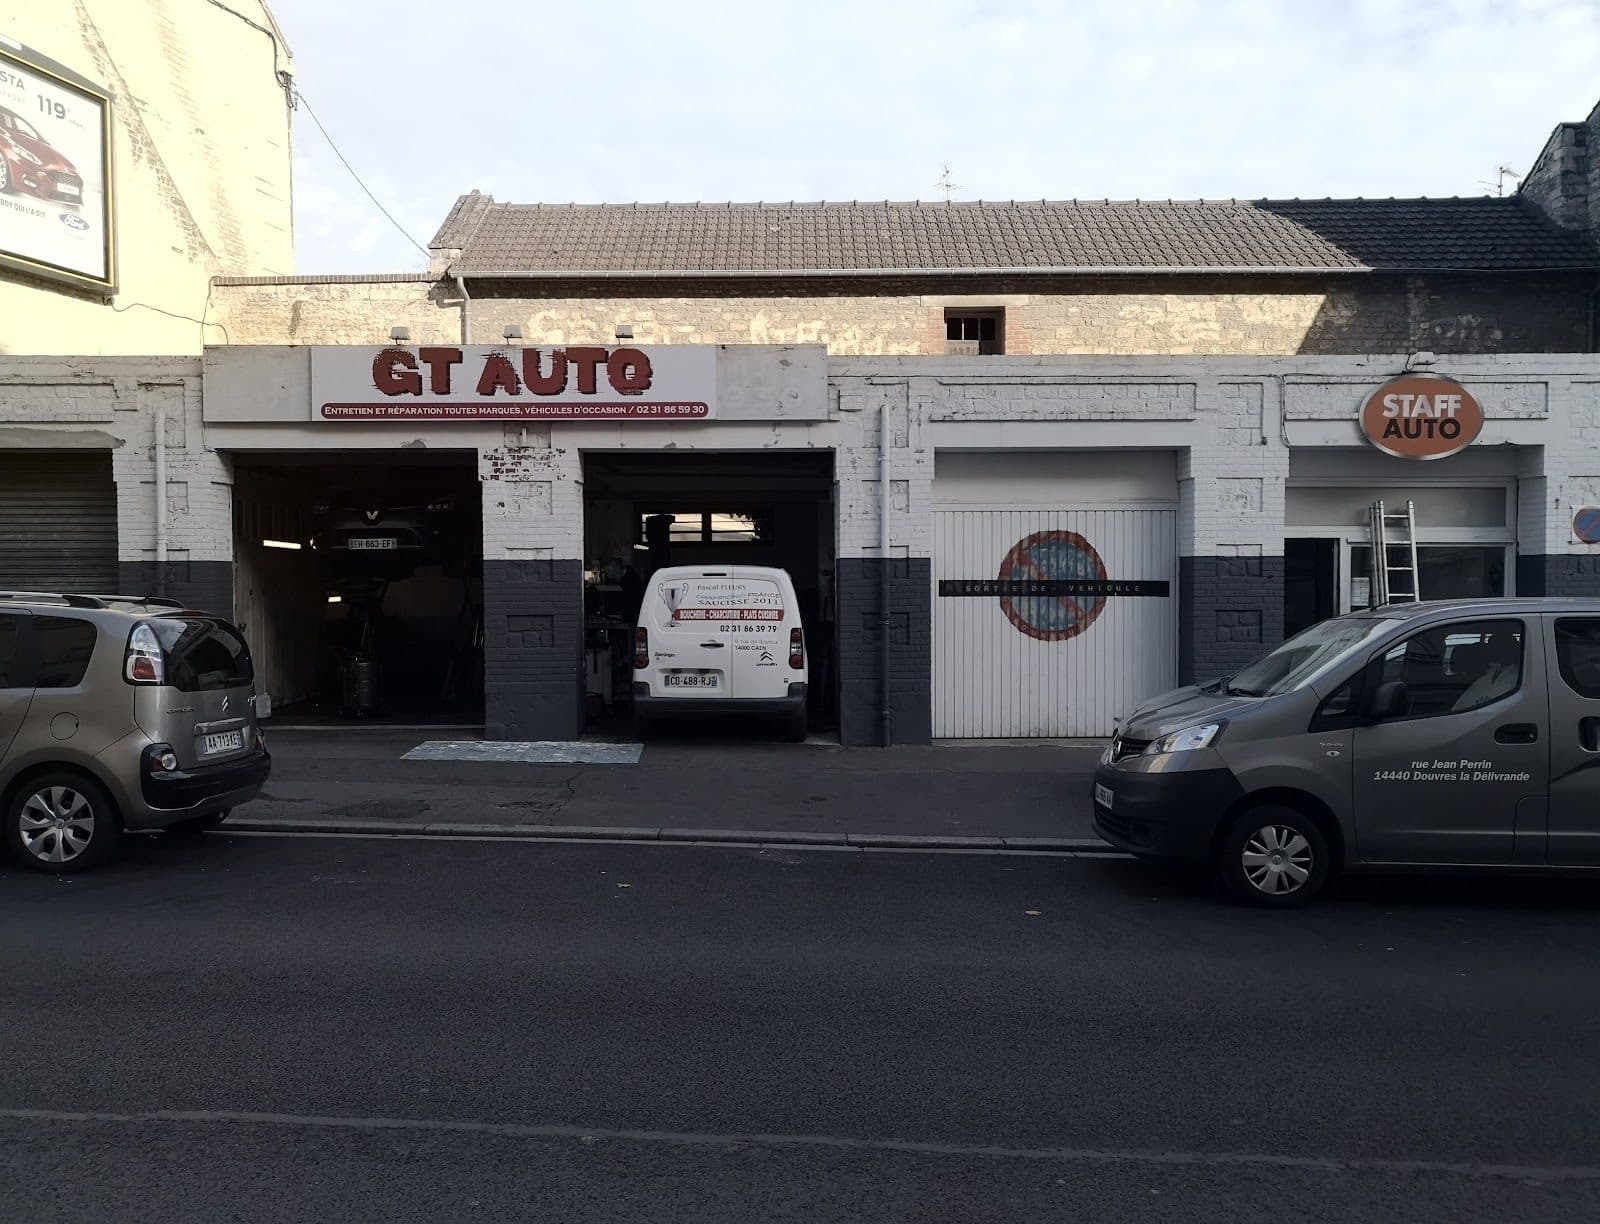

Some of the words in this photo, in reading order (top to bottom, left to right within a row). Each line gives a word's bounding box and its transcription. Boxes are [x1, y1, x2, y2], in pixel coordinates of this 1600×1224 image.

[37, 94, 66, 120] 119
[14, 202, 25, 212] QUI
[371, 346, 463, 396] GT
[476, 346, 653, 396] AUTO
[324, 406, 374, 415] ENTRETIEN
[375, 407, 387, 415] ET
[387, 405, 443, 415] RÉPARATION
[444, 407, 478, 415] TOUTES
[479, 407, 523, 416] MARQUES,
[525, 405, 573, 414] VÉHICULES
[574, 406, 627, 414] D'OCCASION
[636, 405, 650, 414] 02
[650, 405, 661, 414] 31
[664, 405, 677, 414] 86
[678, 405, 691, 414] 59
[692, 405, 705, 414] 30
[1382, 393, 1462, 418] STAFF
[1382, 418, 1462, 440] AUTO
[965, 584, 1019, 593] SORTIE
[1031, 584, 1047, 593] DE
[697, 598, 749, 606] SAUCISSE
[753, 598, 779, 606] 2011
[744, 609, 758, 620] PLATS
[720, 625, 730, 633] 02
[731, 625, 741, 633] 31
[744, 625, 754, 633] 86
[756, 625, 766, 633] 39
[767, 625, 777, 633] 79
[1411, 760, 1429, 769] rue
[1432, 759, 1457, 769] Jean
[1459, 759, 1492, 769] Perrin
[1373, 771, 1411, 781] 14440
[1413, 771, 1457, 781] Douvres
[1459, 771, 1470, 781] la
[1473, 771, 1530, 781] Délivrande
